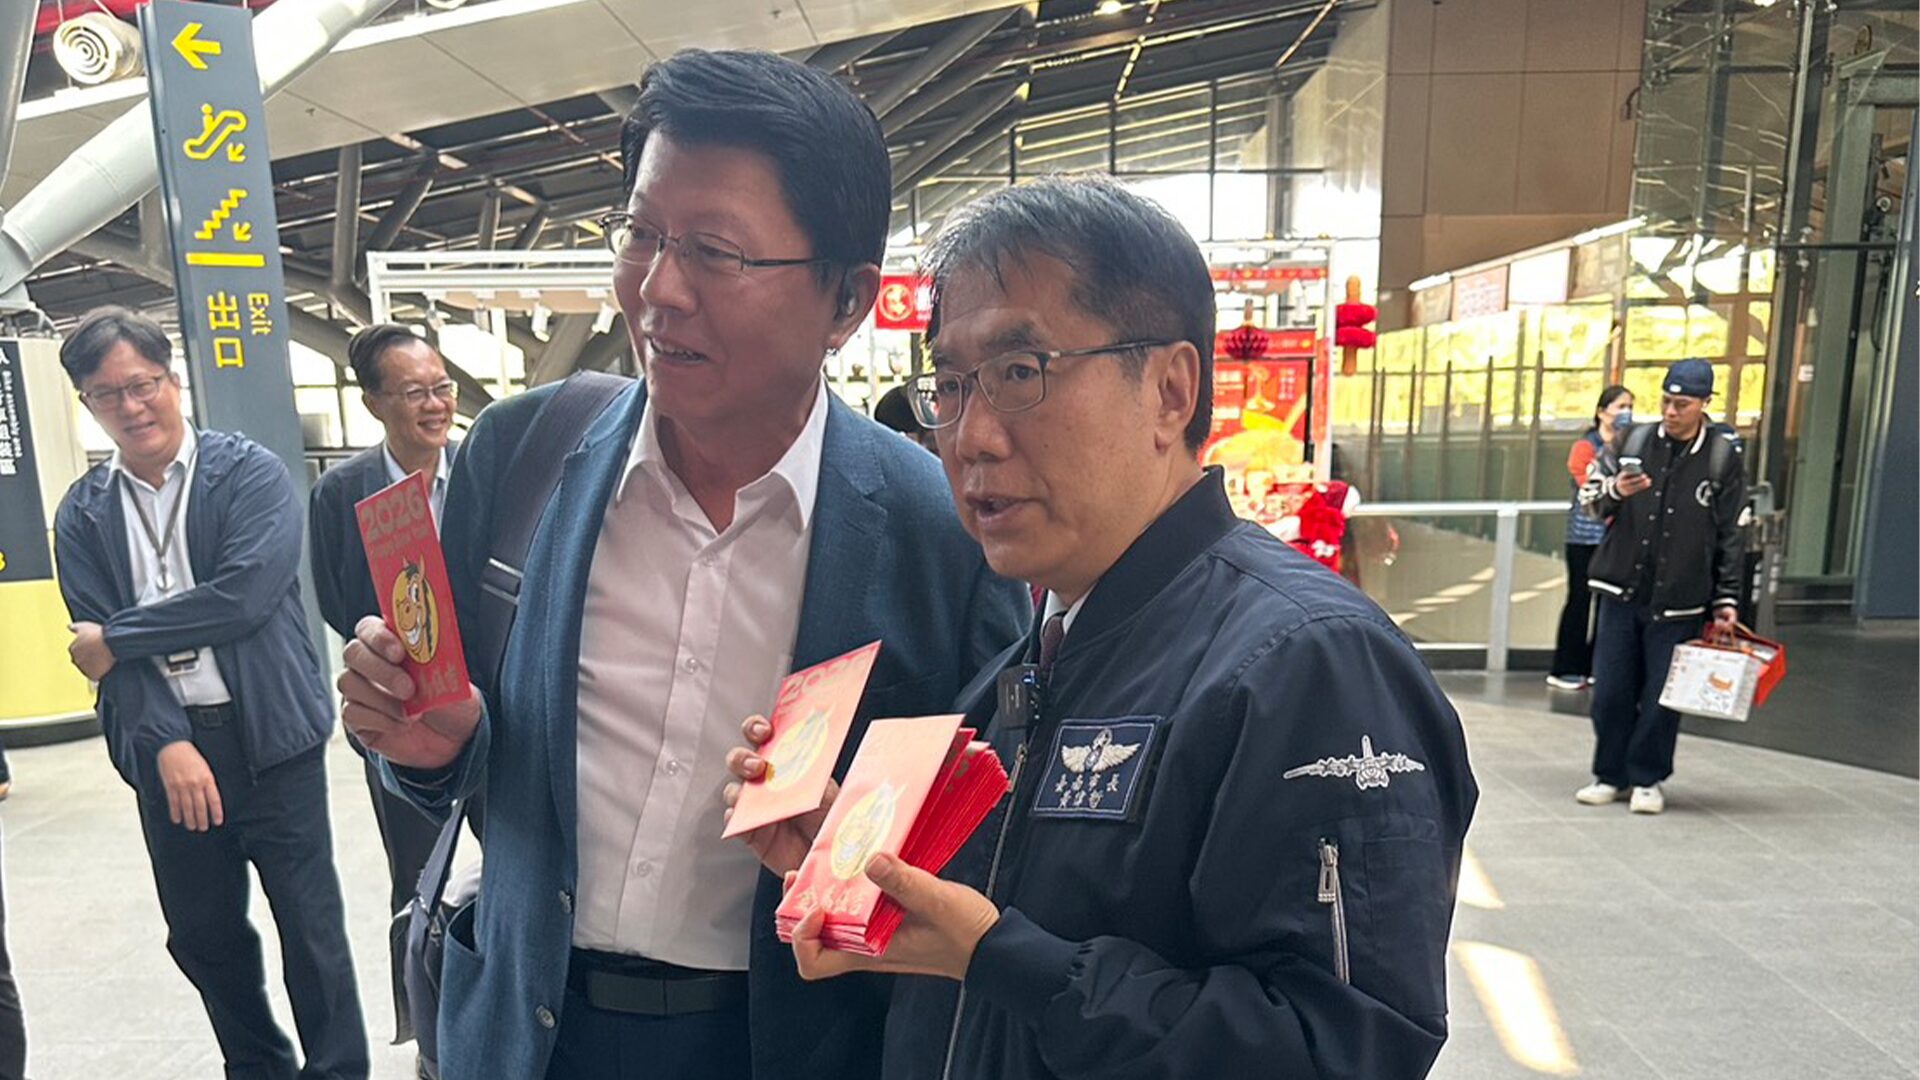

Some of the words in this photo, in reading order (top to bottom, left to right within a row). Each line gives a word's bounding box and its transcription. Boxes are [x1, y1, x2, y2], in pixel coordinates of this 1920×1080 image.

[207, 290, 244, 369] 出口
[247, 292, 272, 335] Exit
[361, 485, 425, 542] 2026
